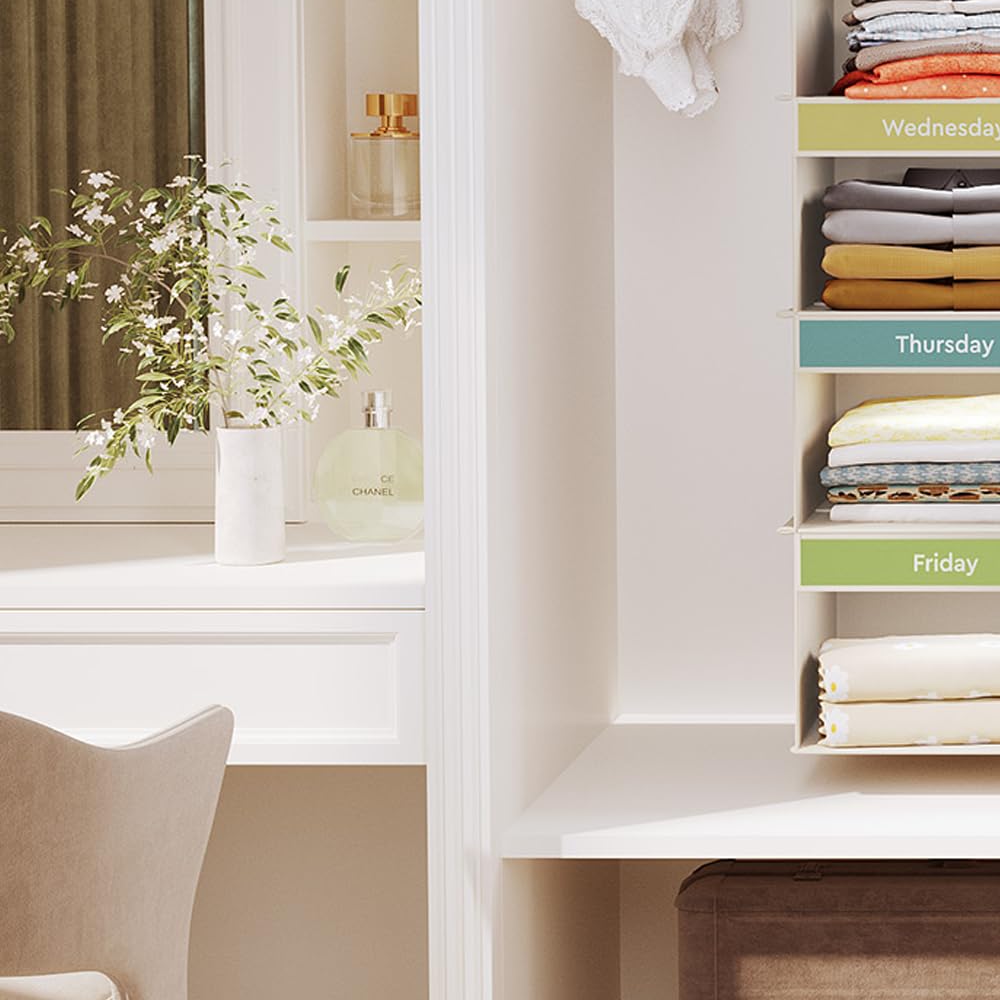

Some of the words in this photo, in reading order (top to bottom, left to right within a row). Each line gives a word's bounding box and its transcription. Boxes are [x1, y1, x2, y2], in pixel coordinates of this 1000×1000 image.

[895, 333, 995, 358] Thursday
[352, 487, 394, 497] CHANEL
[913, 551, 979, 577] Friday
